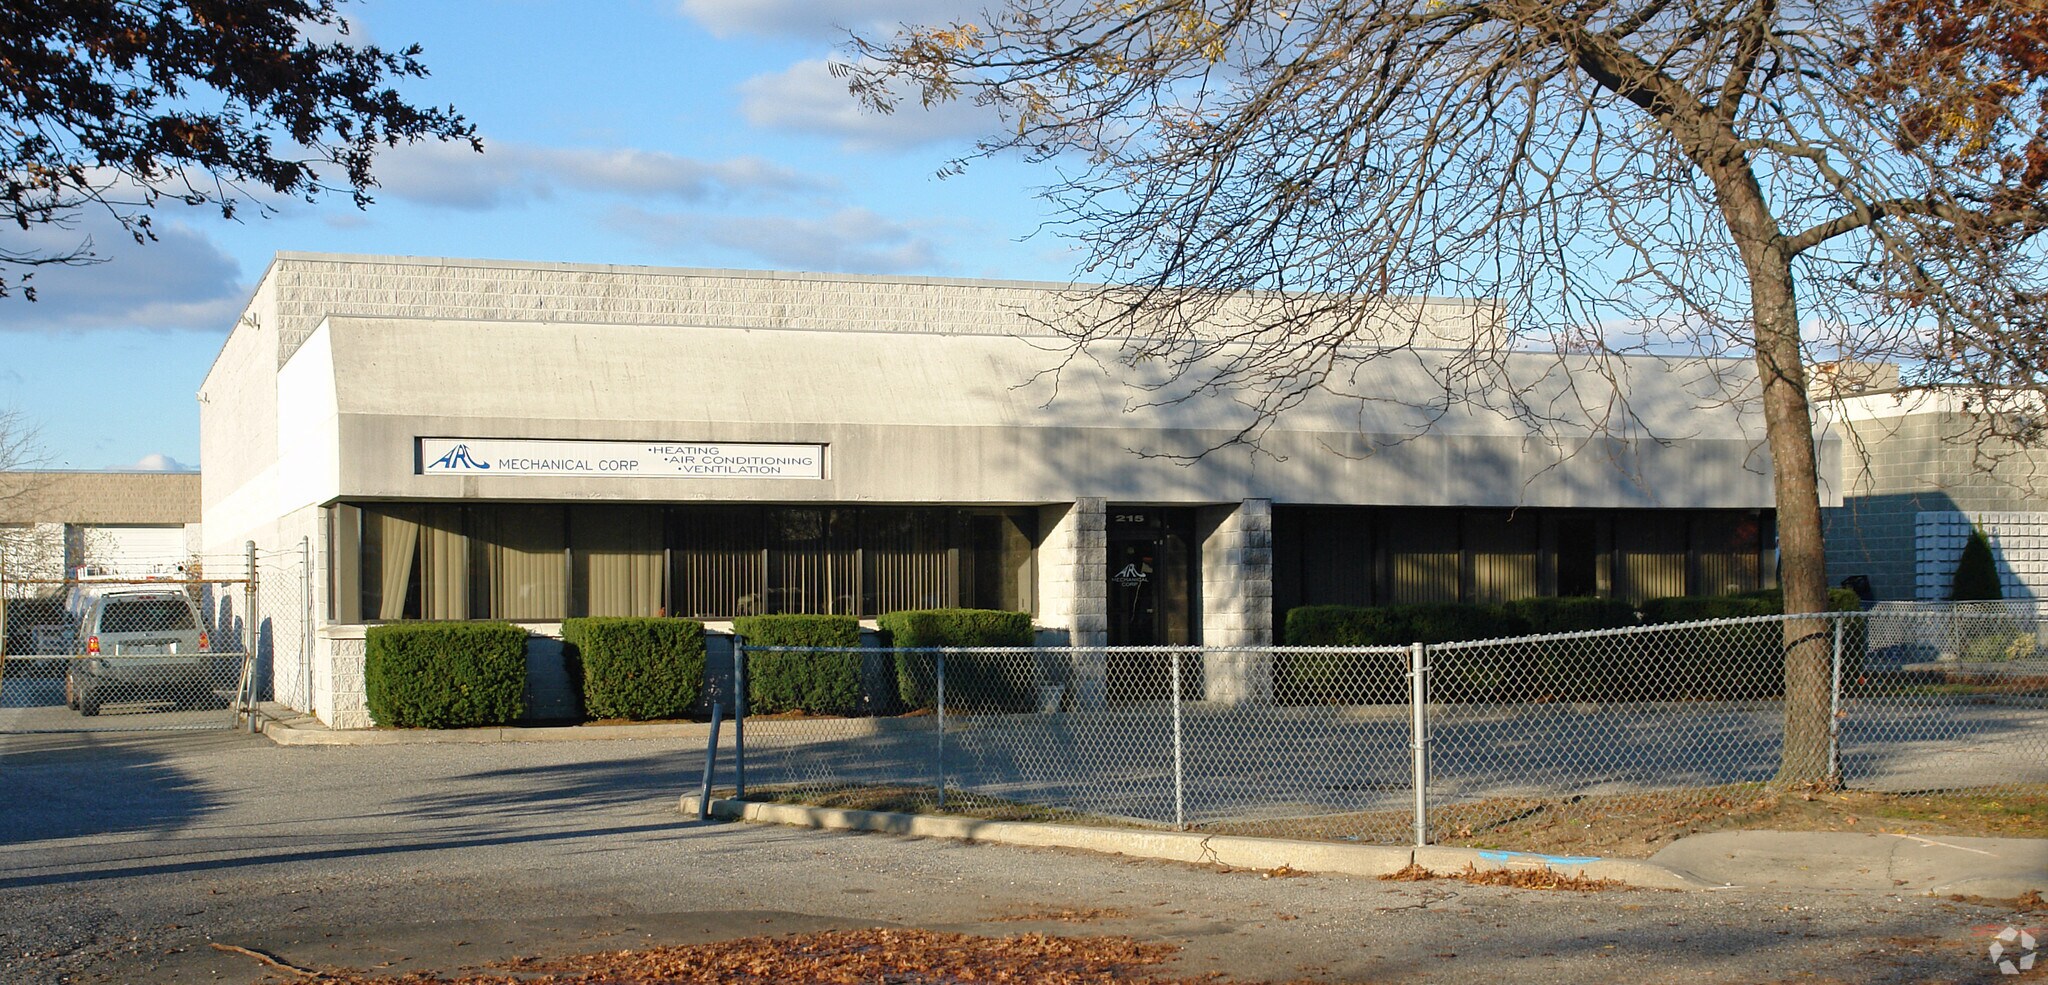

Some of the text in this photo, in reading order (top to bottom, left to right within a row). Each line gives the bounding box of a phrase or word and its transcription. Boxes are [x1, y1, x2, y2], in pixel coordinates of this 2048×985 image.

[499, 458, 594, 471] MECHANICAL
[701, 456, 813, 466] CONDITIONING
[1115, 514, 1145, 523] 215
